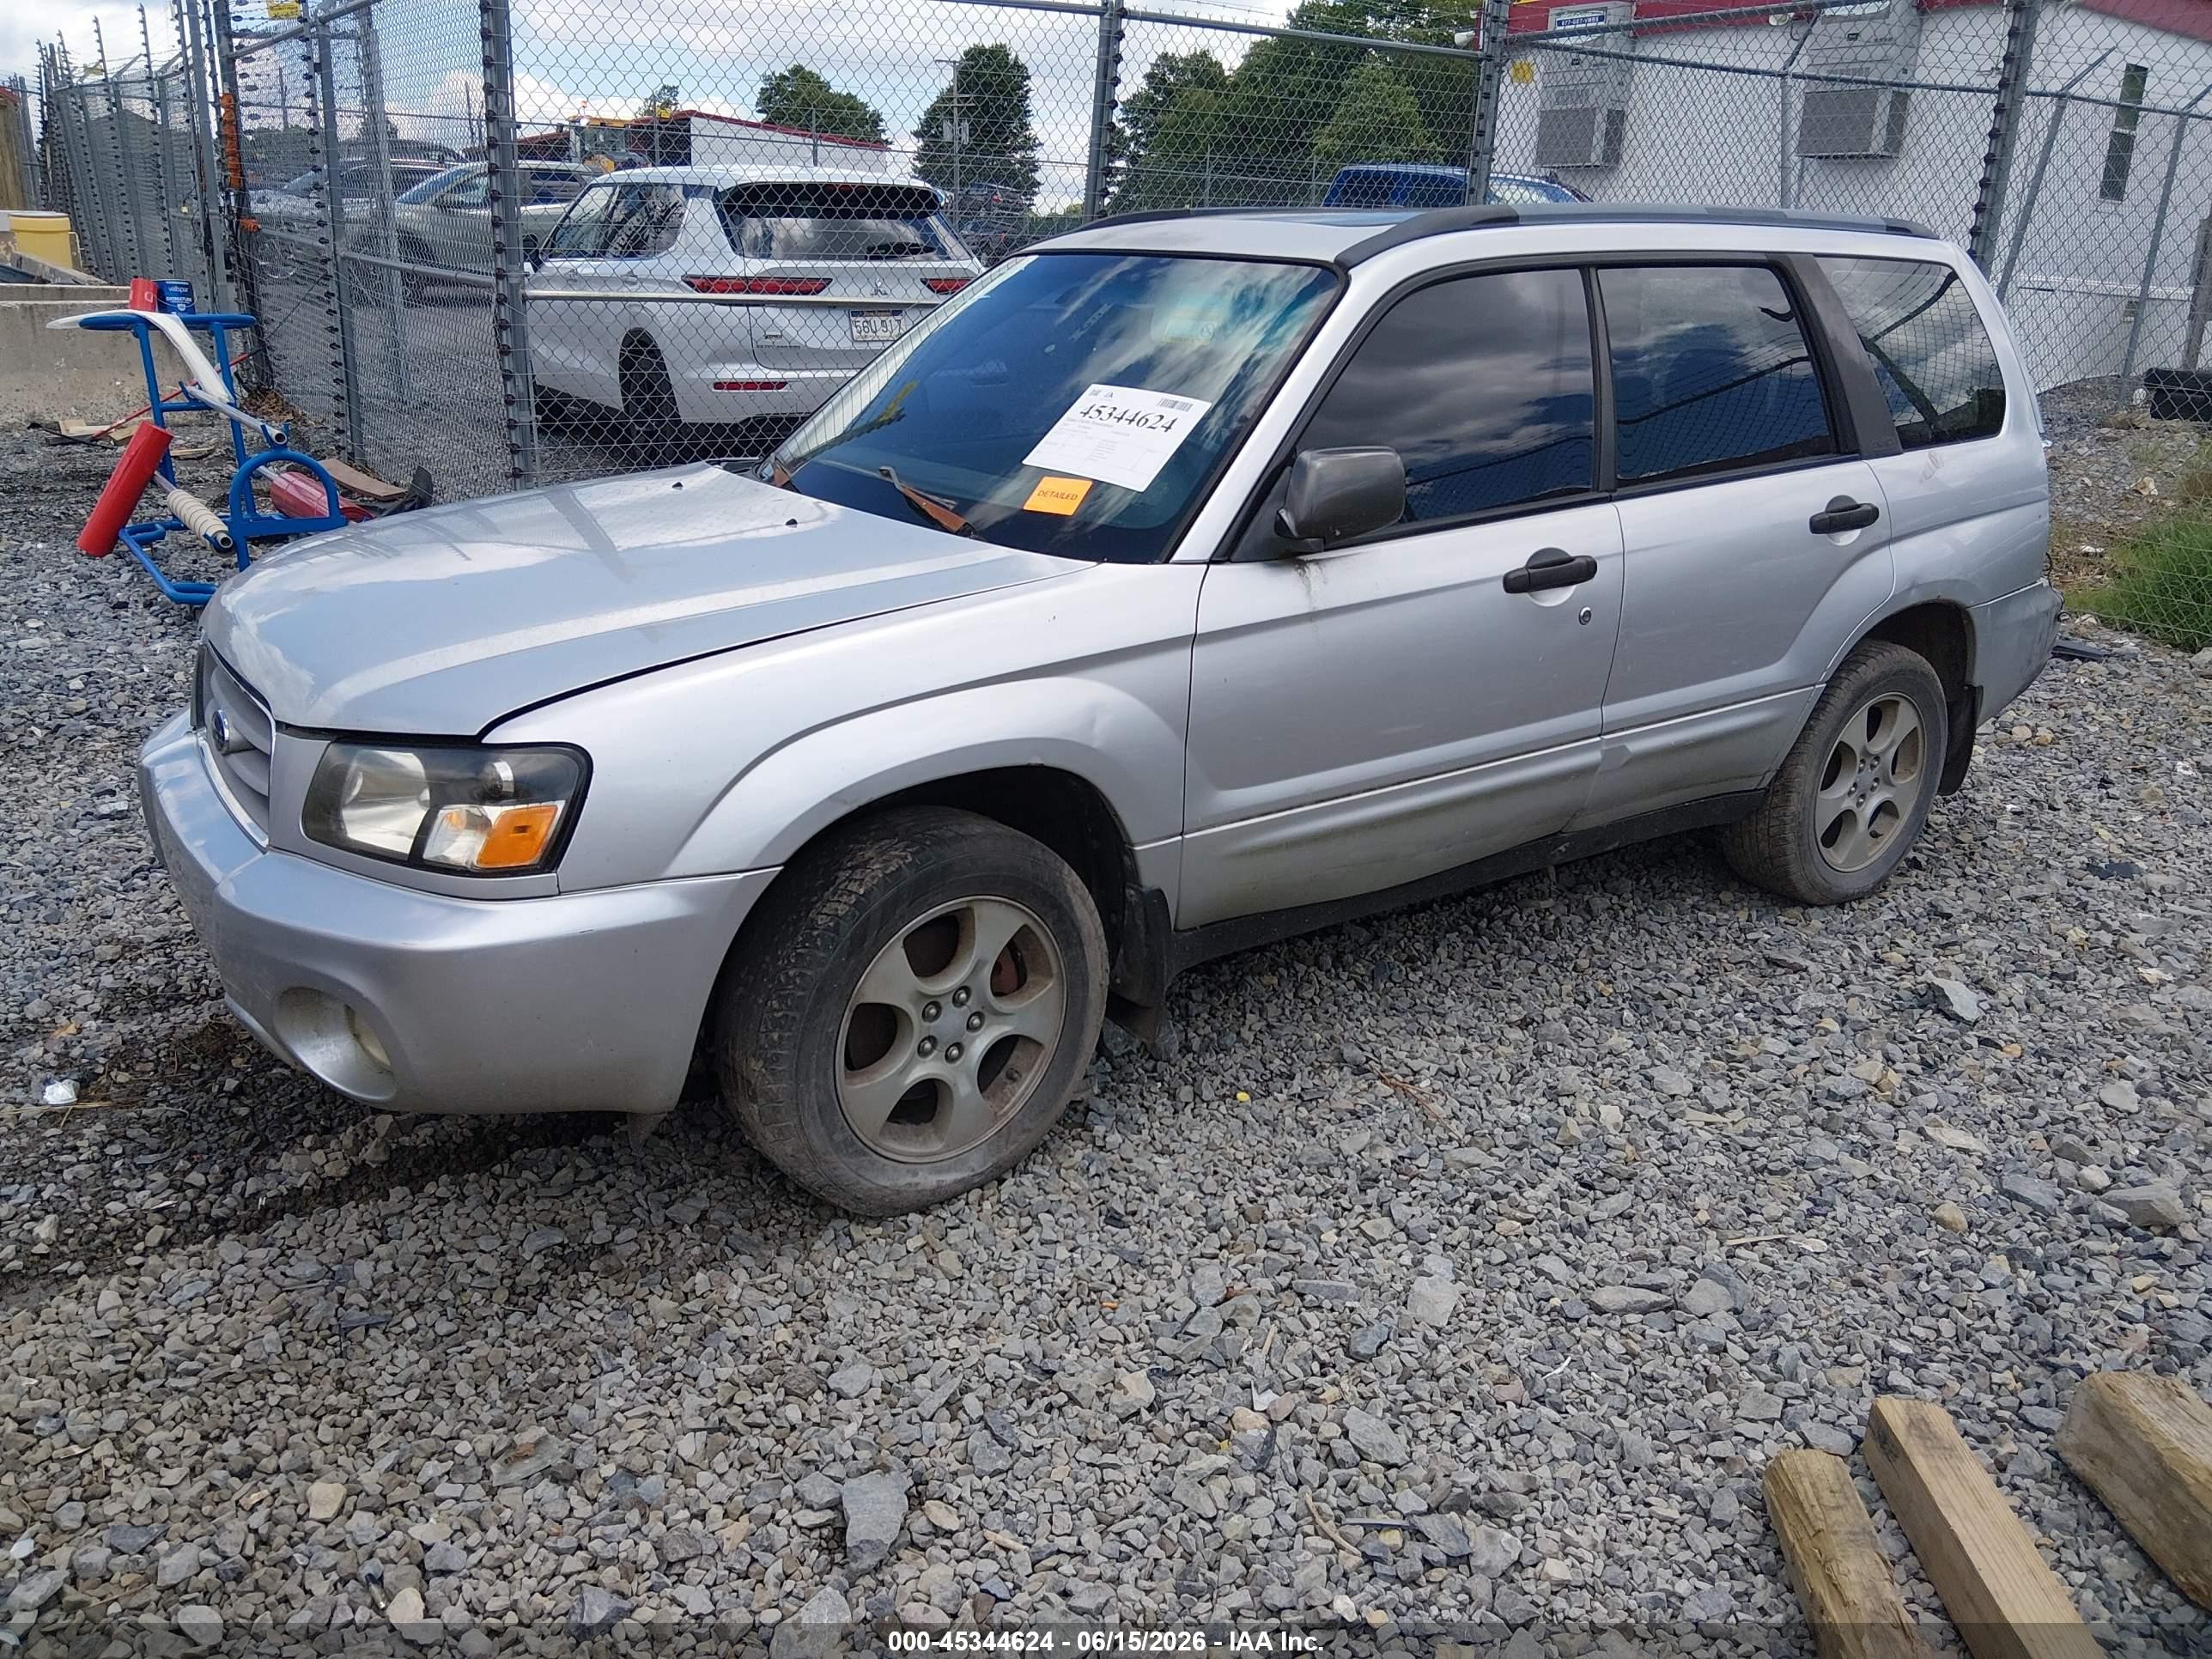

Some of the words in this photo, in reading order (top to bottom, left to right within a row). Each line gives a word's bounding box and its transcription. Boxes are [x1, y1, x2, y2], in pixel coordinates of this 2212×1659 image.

[167, 285, 189, 294] valspar
[1079, 404, 1178, 433] 45344624
[1037, 490, 1078, 501] DETAILED
